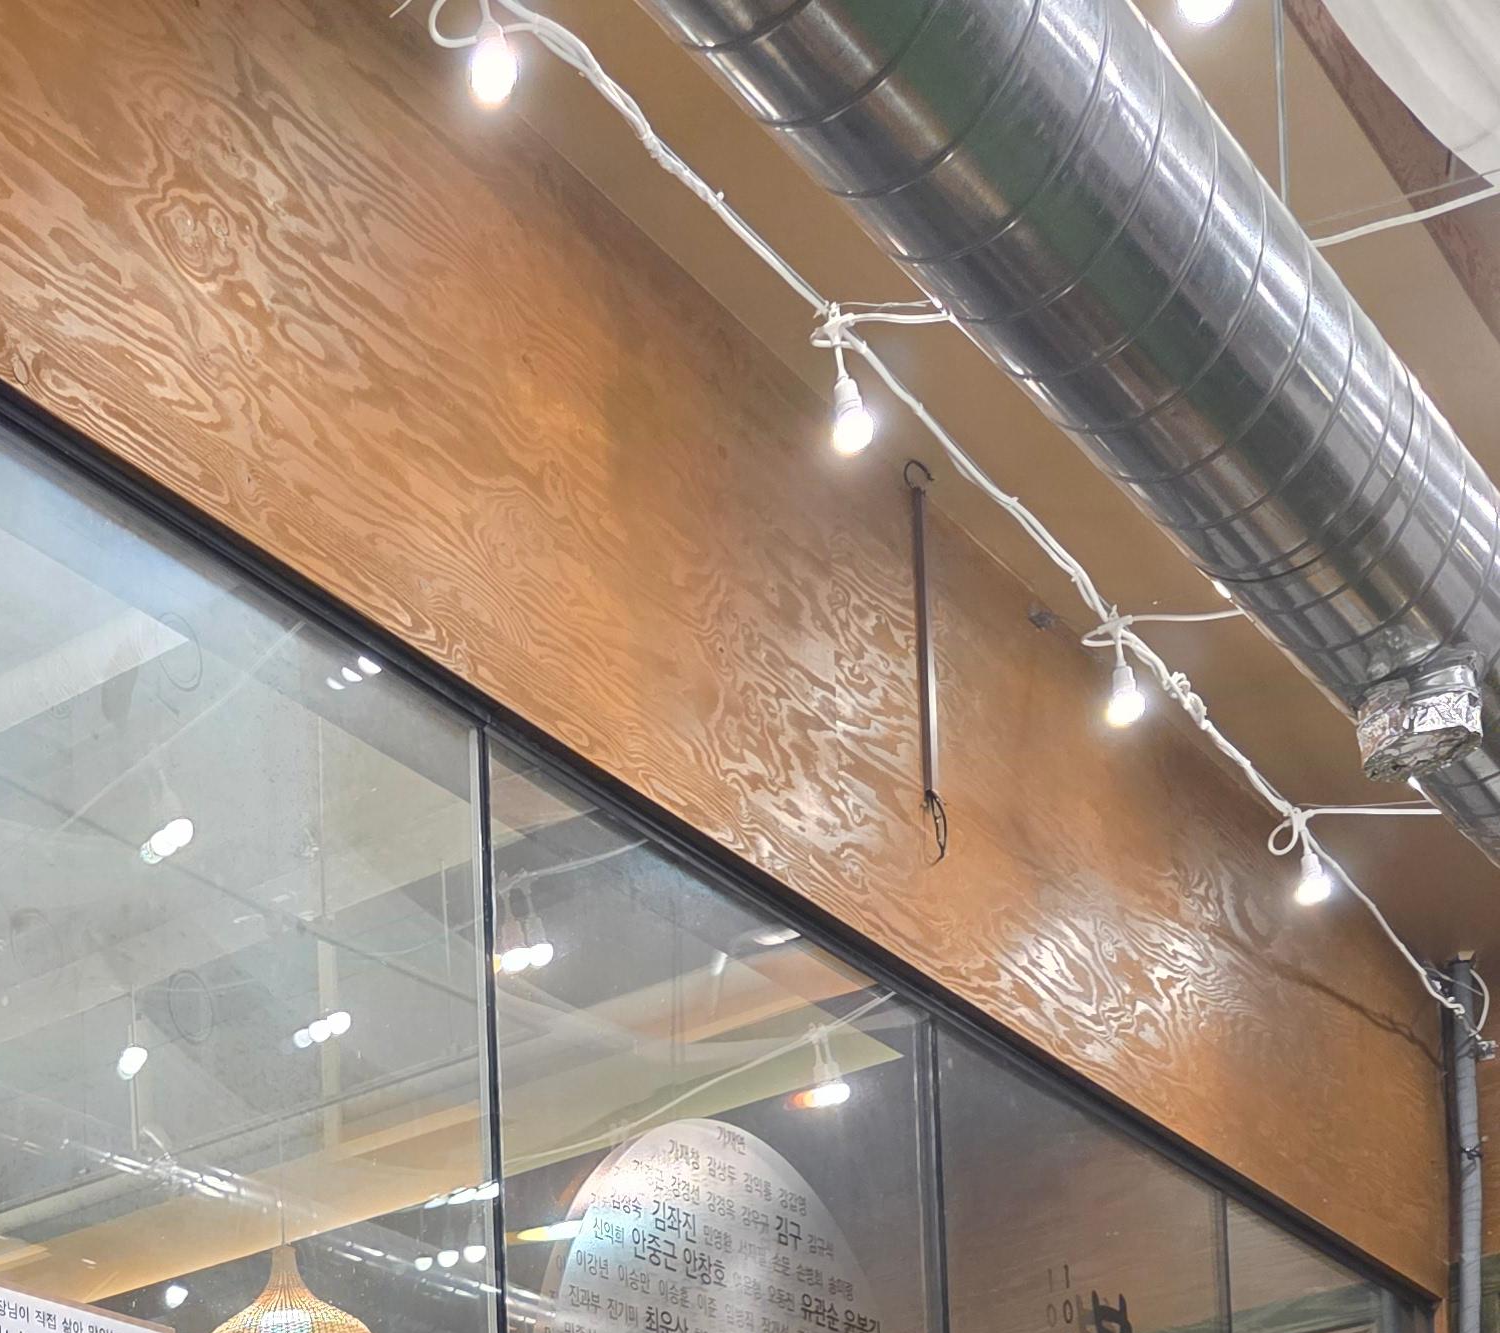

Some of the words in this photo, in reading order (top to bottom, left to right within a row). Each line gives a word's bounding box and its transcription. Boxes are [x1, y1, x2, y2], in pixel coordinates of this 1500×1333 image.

[651, 1199, 698, 1245] 김좌진
[775, 1215, 803, 1250] 김구
[631, 1227, 678, 1272] 안중근
[683, 1247, 728, 1289] 안창호
[801, 1293, 840, 1333] 유관순
[34, 1309, 57, 1331] 직접
